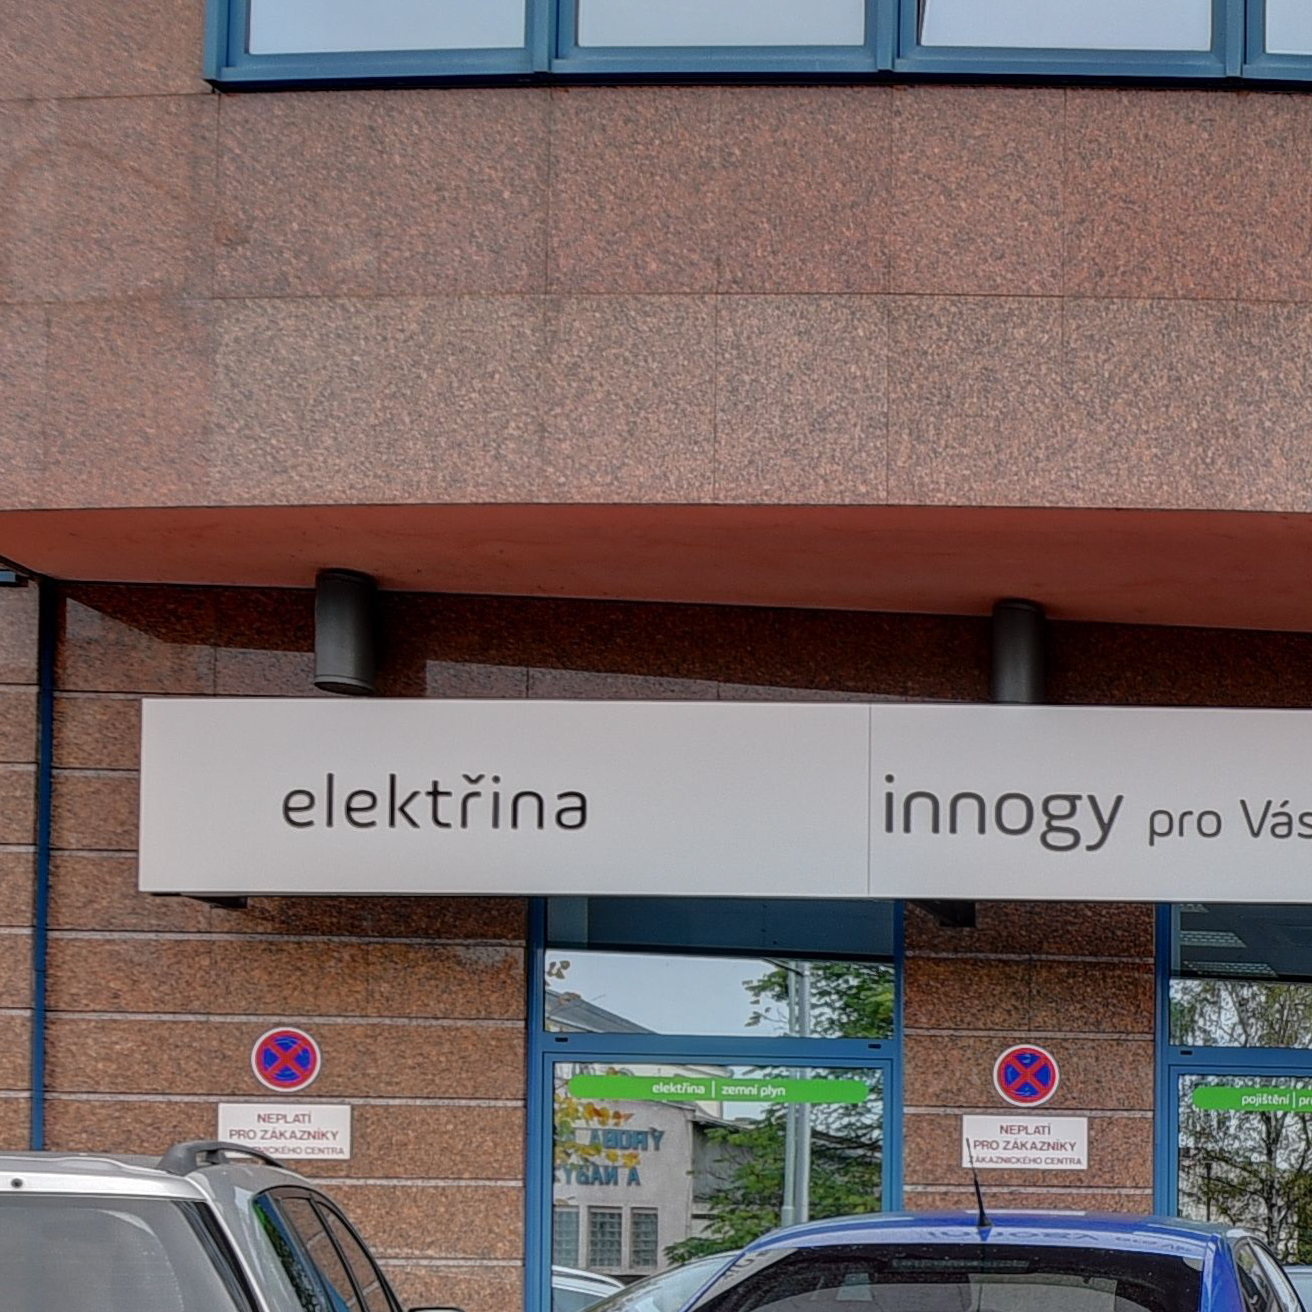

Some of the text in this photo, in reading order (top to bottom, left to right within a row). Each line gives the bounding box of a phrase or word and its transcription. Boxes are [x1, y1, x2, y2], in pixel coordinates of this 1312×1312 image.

[281, 773, 588, 831] elektřina
[883, 774, 1124, 851] innogy
[1148, 805, 1223, 846] pro
[652, 1082, 786, 1098] elektřina zemní plyn
[1241, 1093, 1289, 1106] pojištění
[257, 1111, 312, 1124] NEPLATÍ
[229, 1127, 339, 1141] PRO ZÁKAZNÍKY
[1000, 1123, 1051, 1135] NEPLATÍ
[305, 1147, 345, 1155] CENTRA
[973, 1138, 1077, 1151] PRO ZÁKAZNÍKY
[1044, 1157, 1082, 1165] CENTRA
